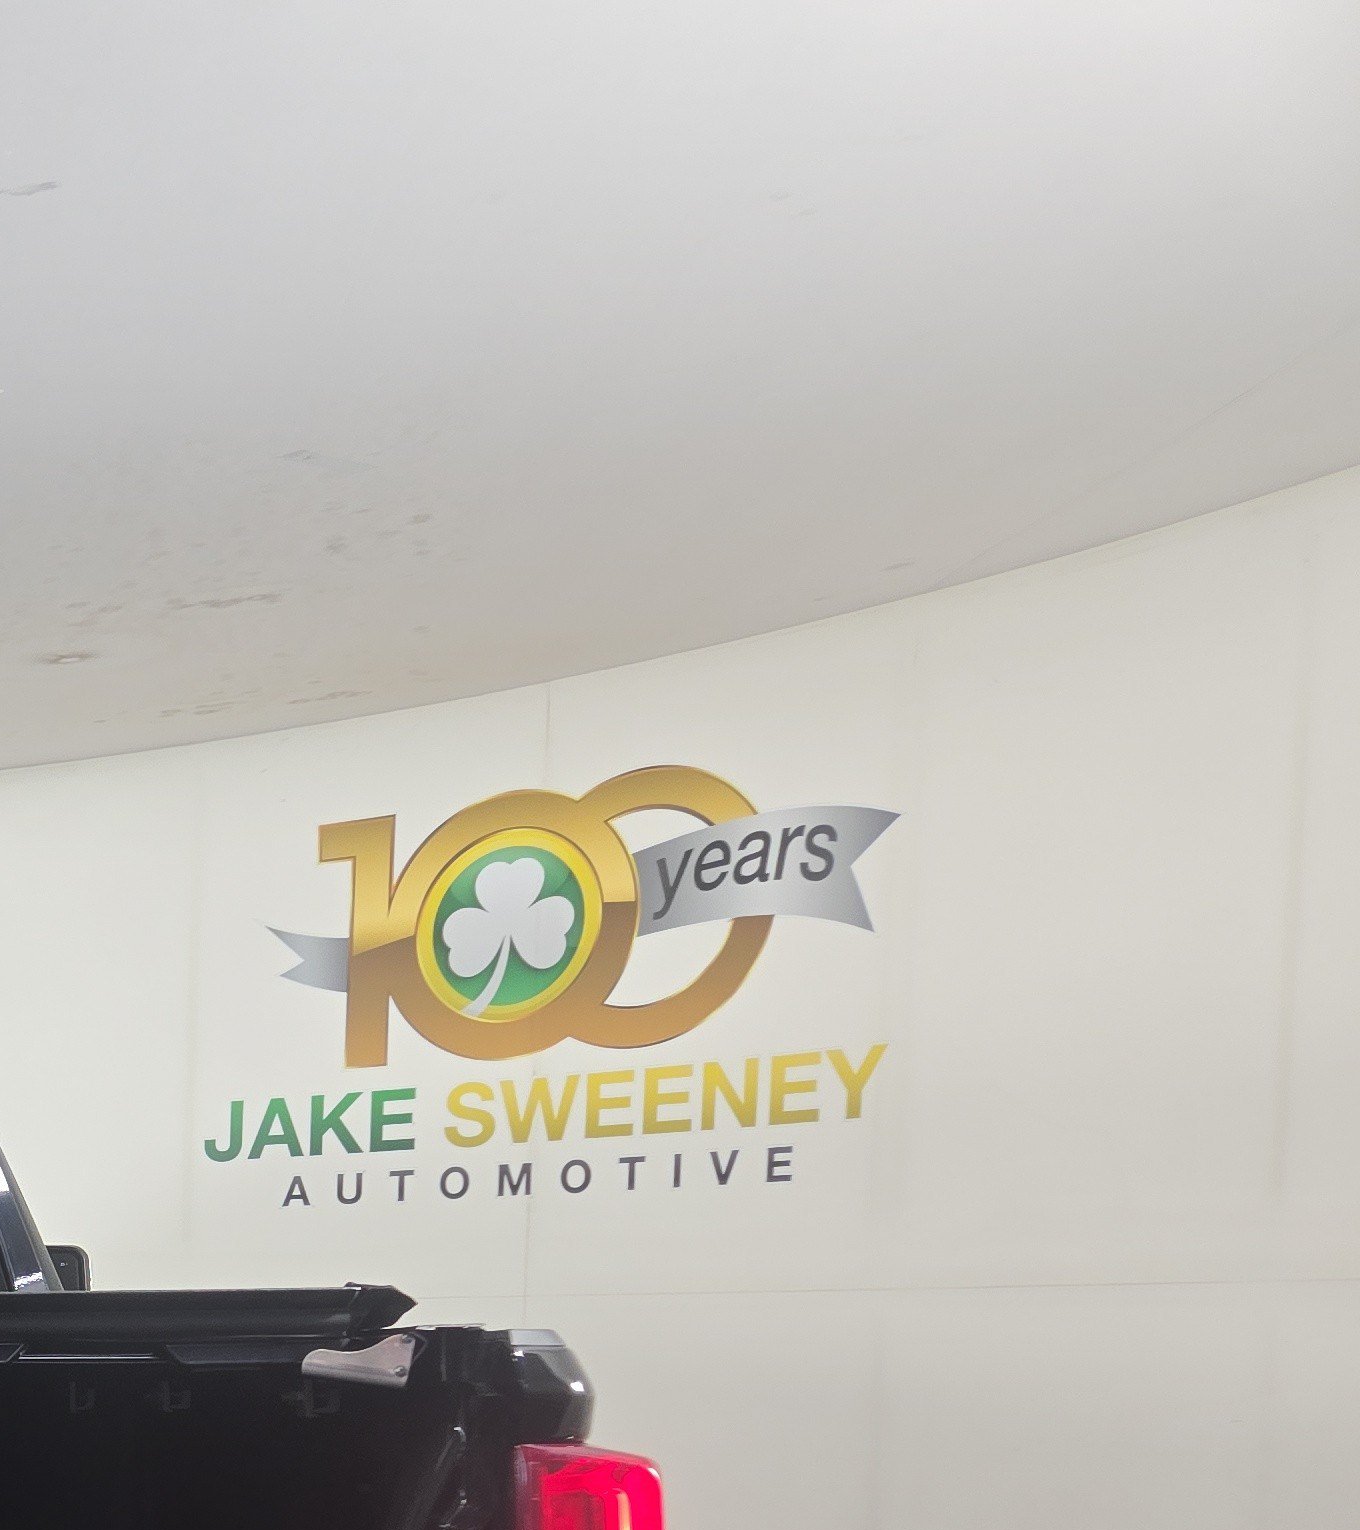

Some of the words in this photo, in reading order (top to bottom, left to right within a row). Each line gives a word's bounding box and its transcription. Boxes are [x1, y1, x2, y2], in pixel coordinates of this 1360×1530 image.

[317, 764, 777, 1069] 100
[652, 822, 839, 920] years
[203, 1086, 418, 1163] JAKE
[443, 1043, 889, 1149] SWEENEY
[281, 1145, 795, 1208] AUTOMOTIVE
